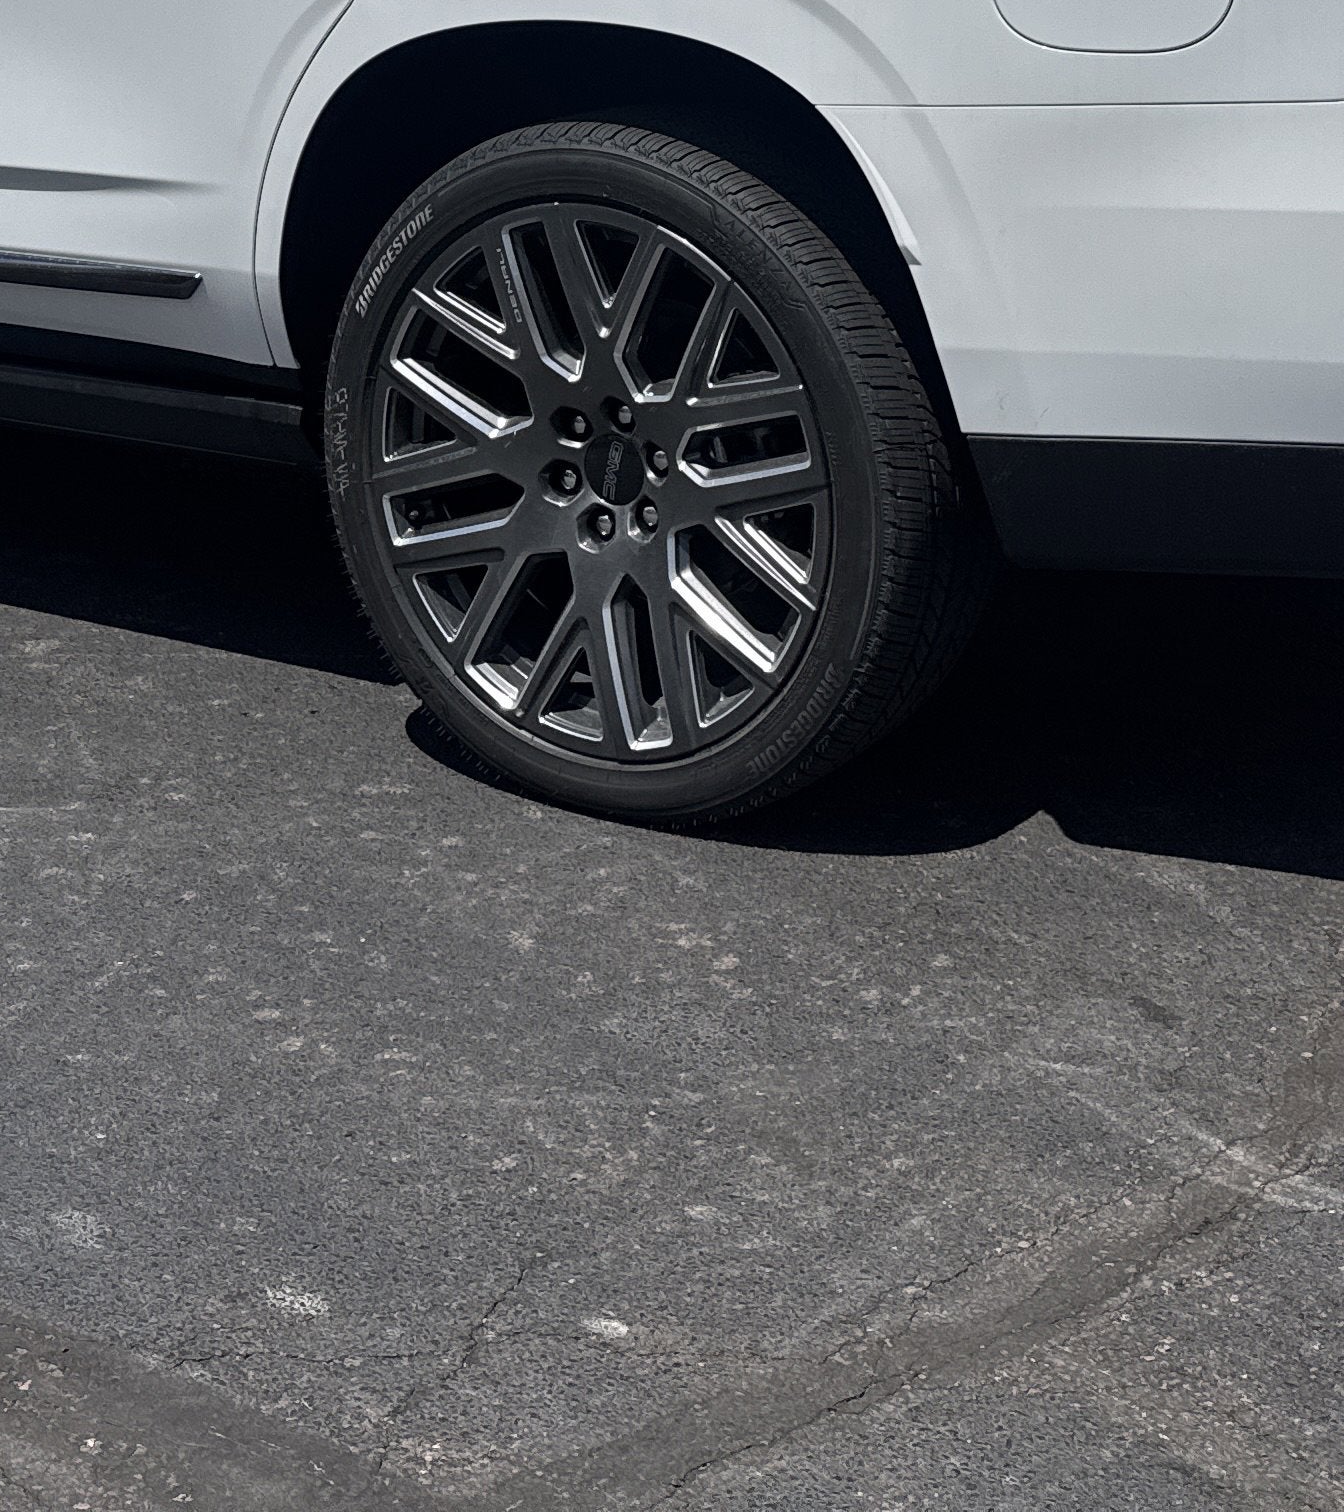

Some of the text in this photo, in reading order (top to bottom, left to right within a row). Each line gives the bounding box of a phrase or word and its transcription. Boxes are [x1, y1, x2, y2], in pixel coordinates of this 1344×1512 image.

[355, 203, 435, 319] BRIDGESTONE
[495, 247, 523, 323] DENALI
[602, 440, 624, 501] GMC
